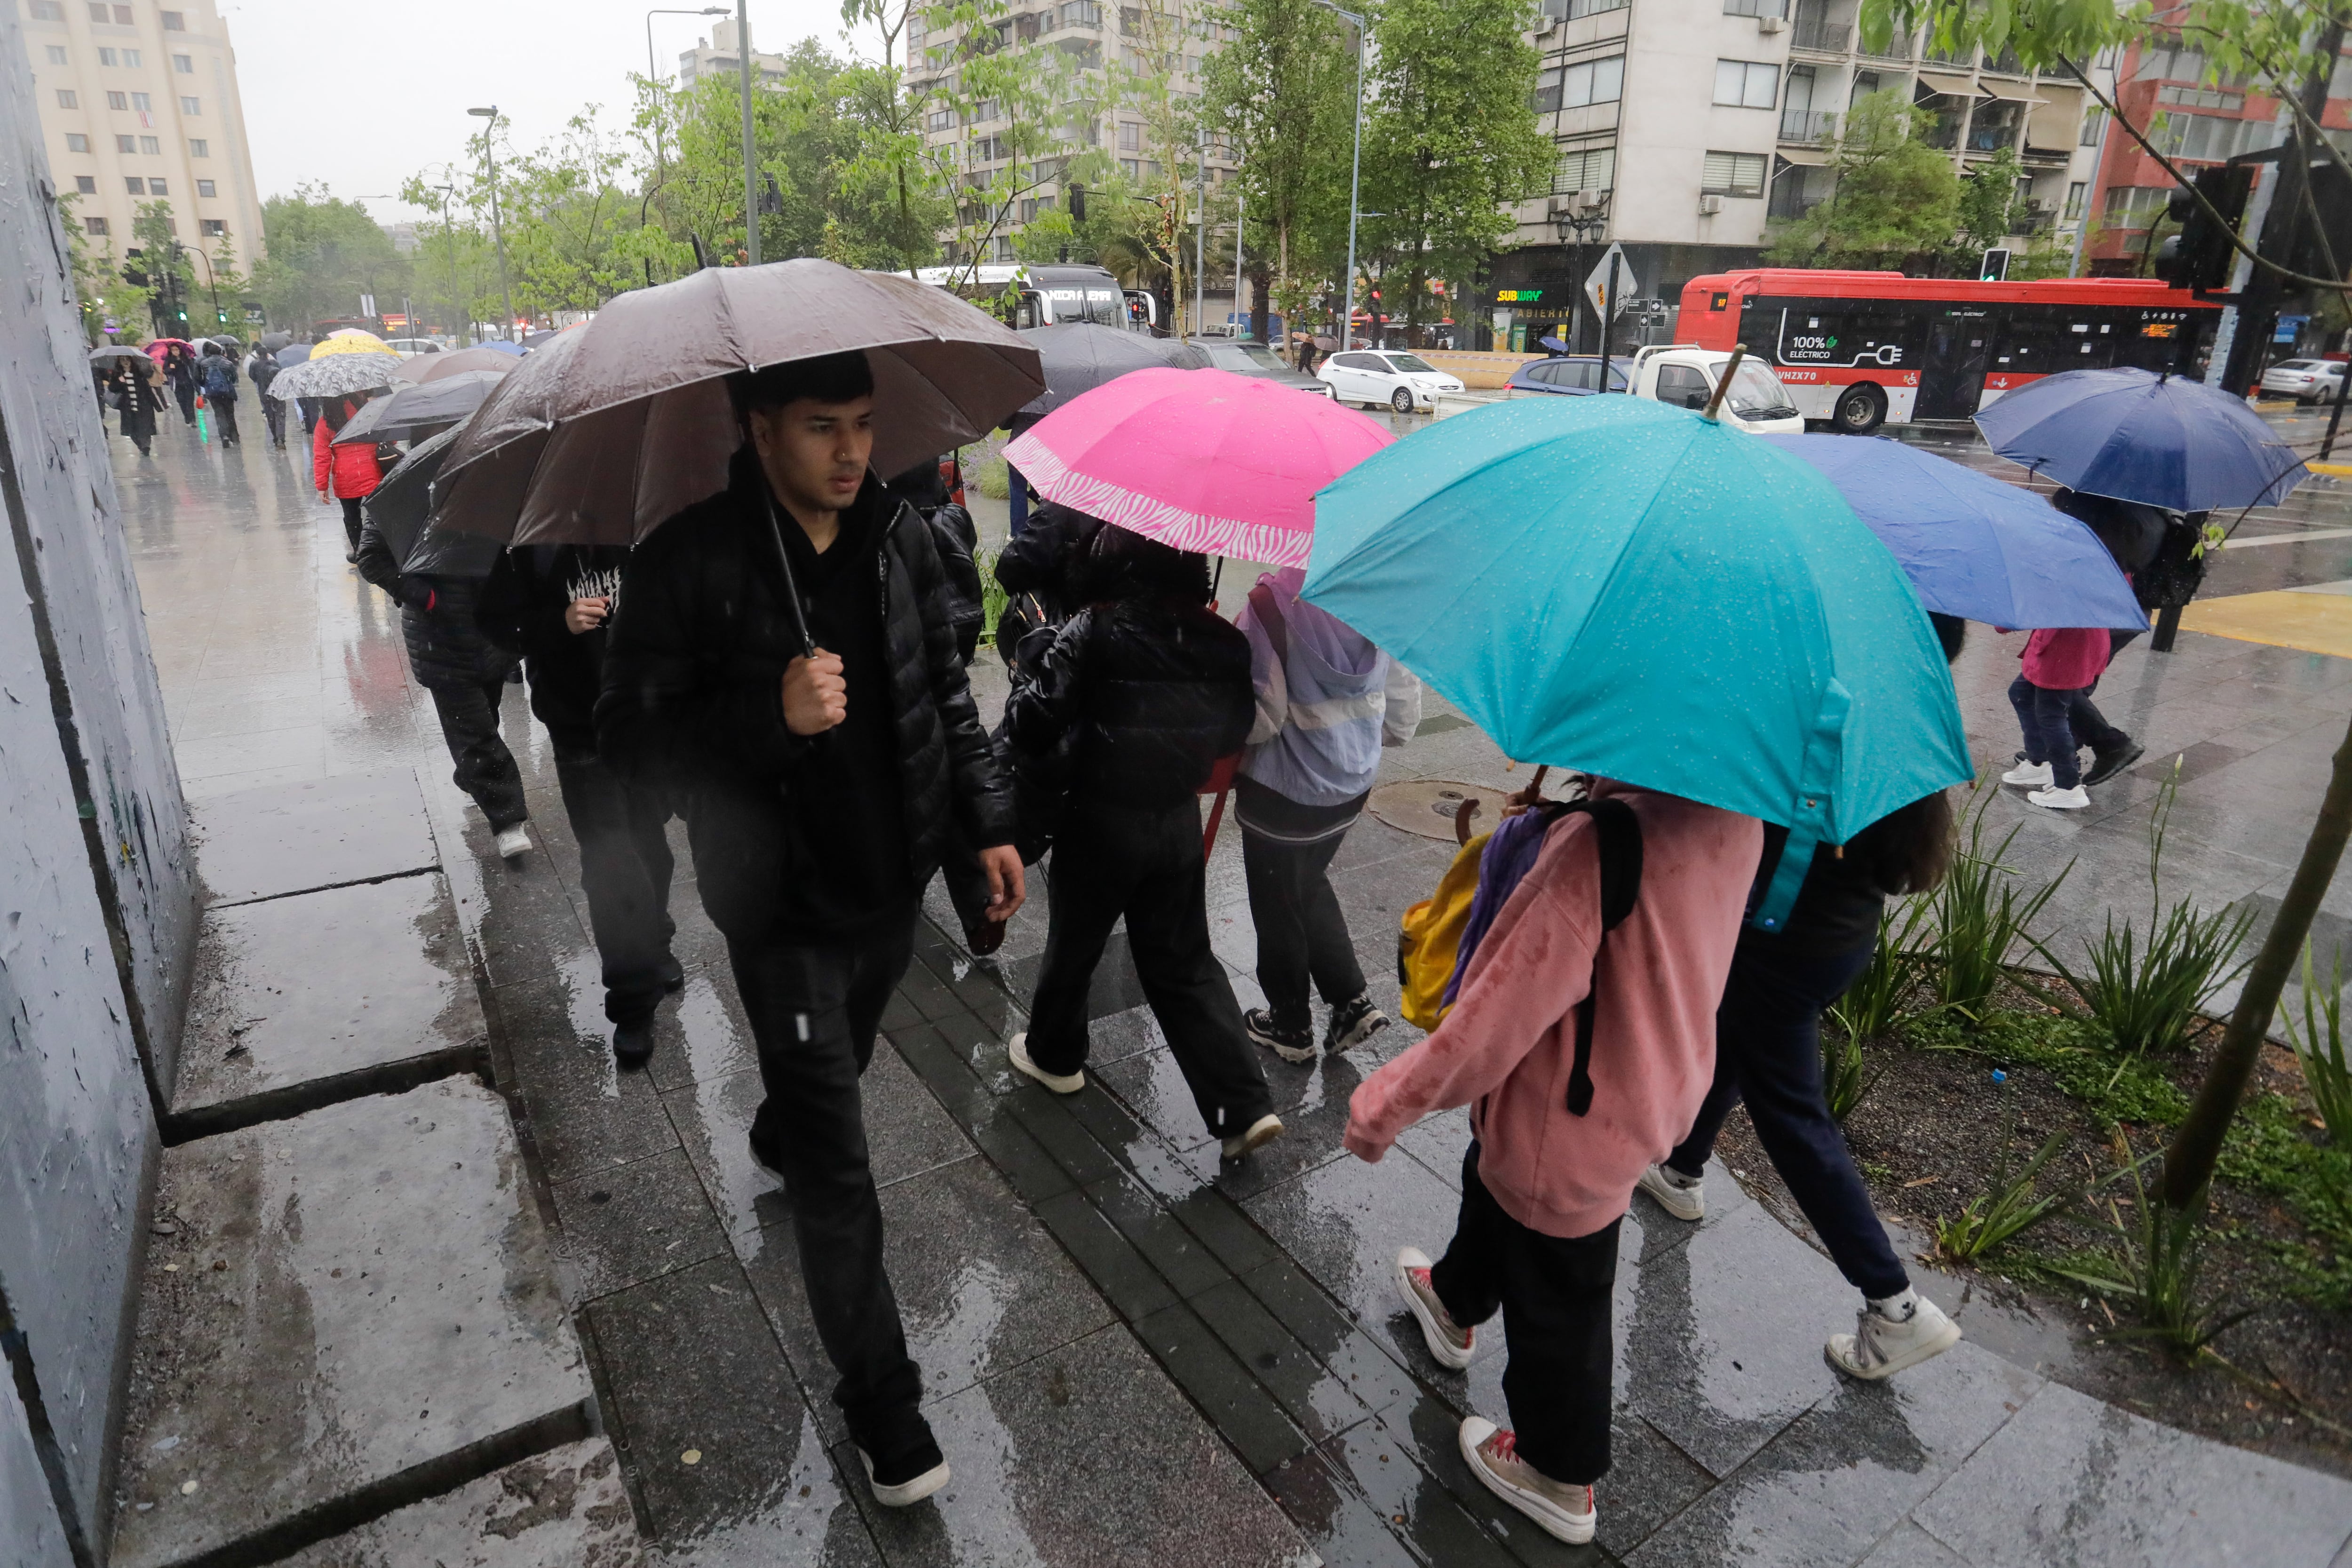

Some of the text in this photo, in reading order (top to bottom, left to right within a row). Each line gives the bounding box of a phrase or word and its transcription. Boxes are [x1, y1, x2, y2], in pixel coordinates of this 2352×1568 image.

[1497, 290, 1543, 302] SUBWAY
[1793, 336, 1825, 349] 100%
[1789, 349, 1830, 358] ELÉCTRICO
[1778, 371, 1817, 380] VHZX70
